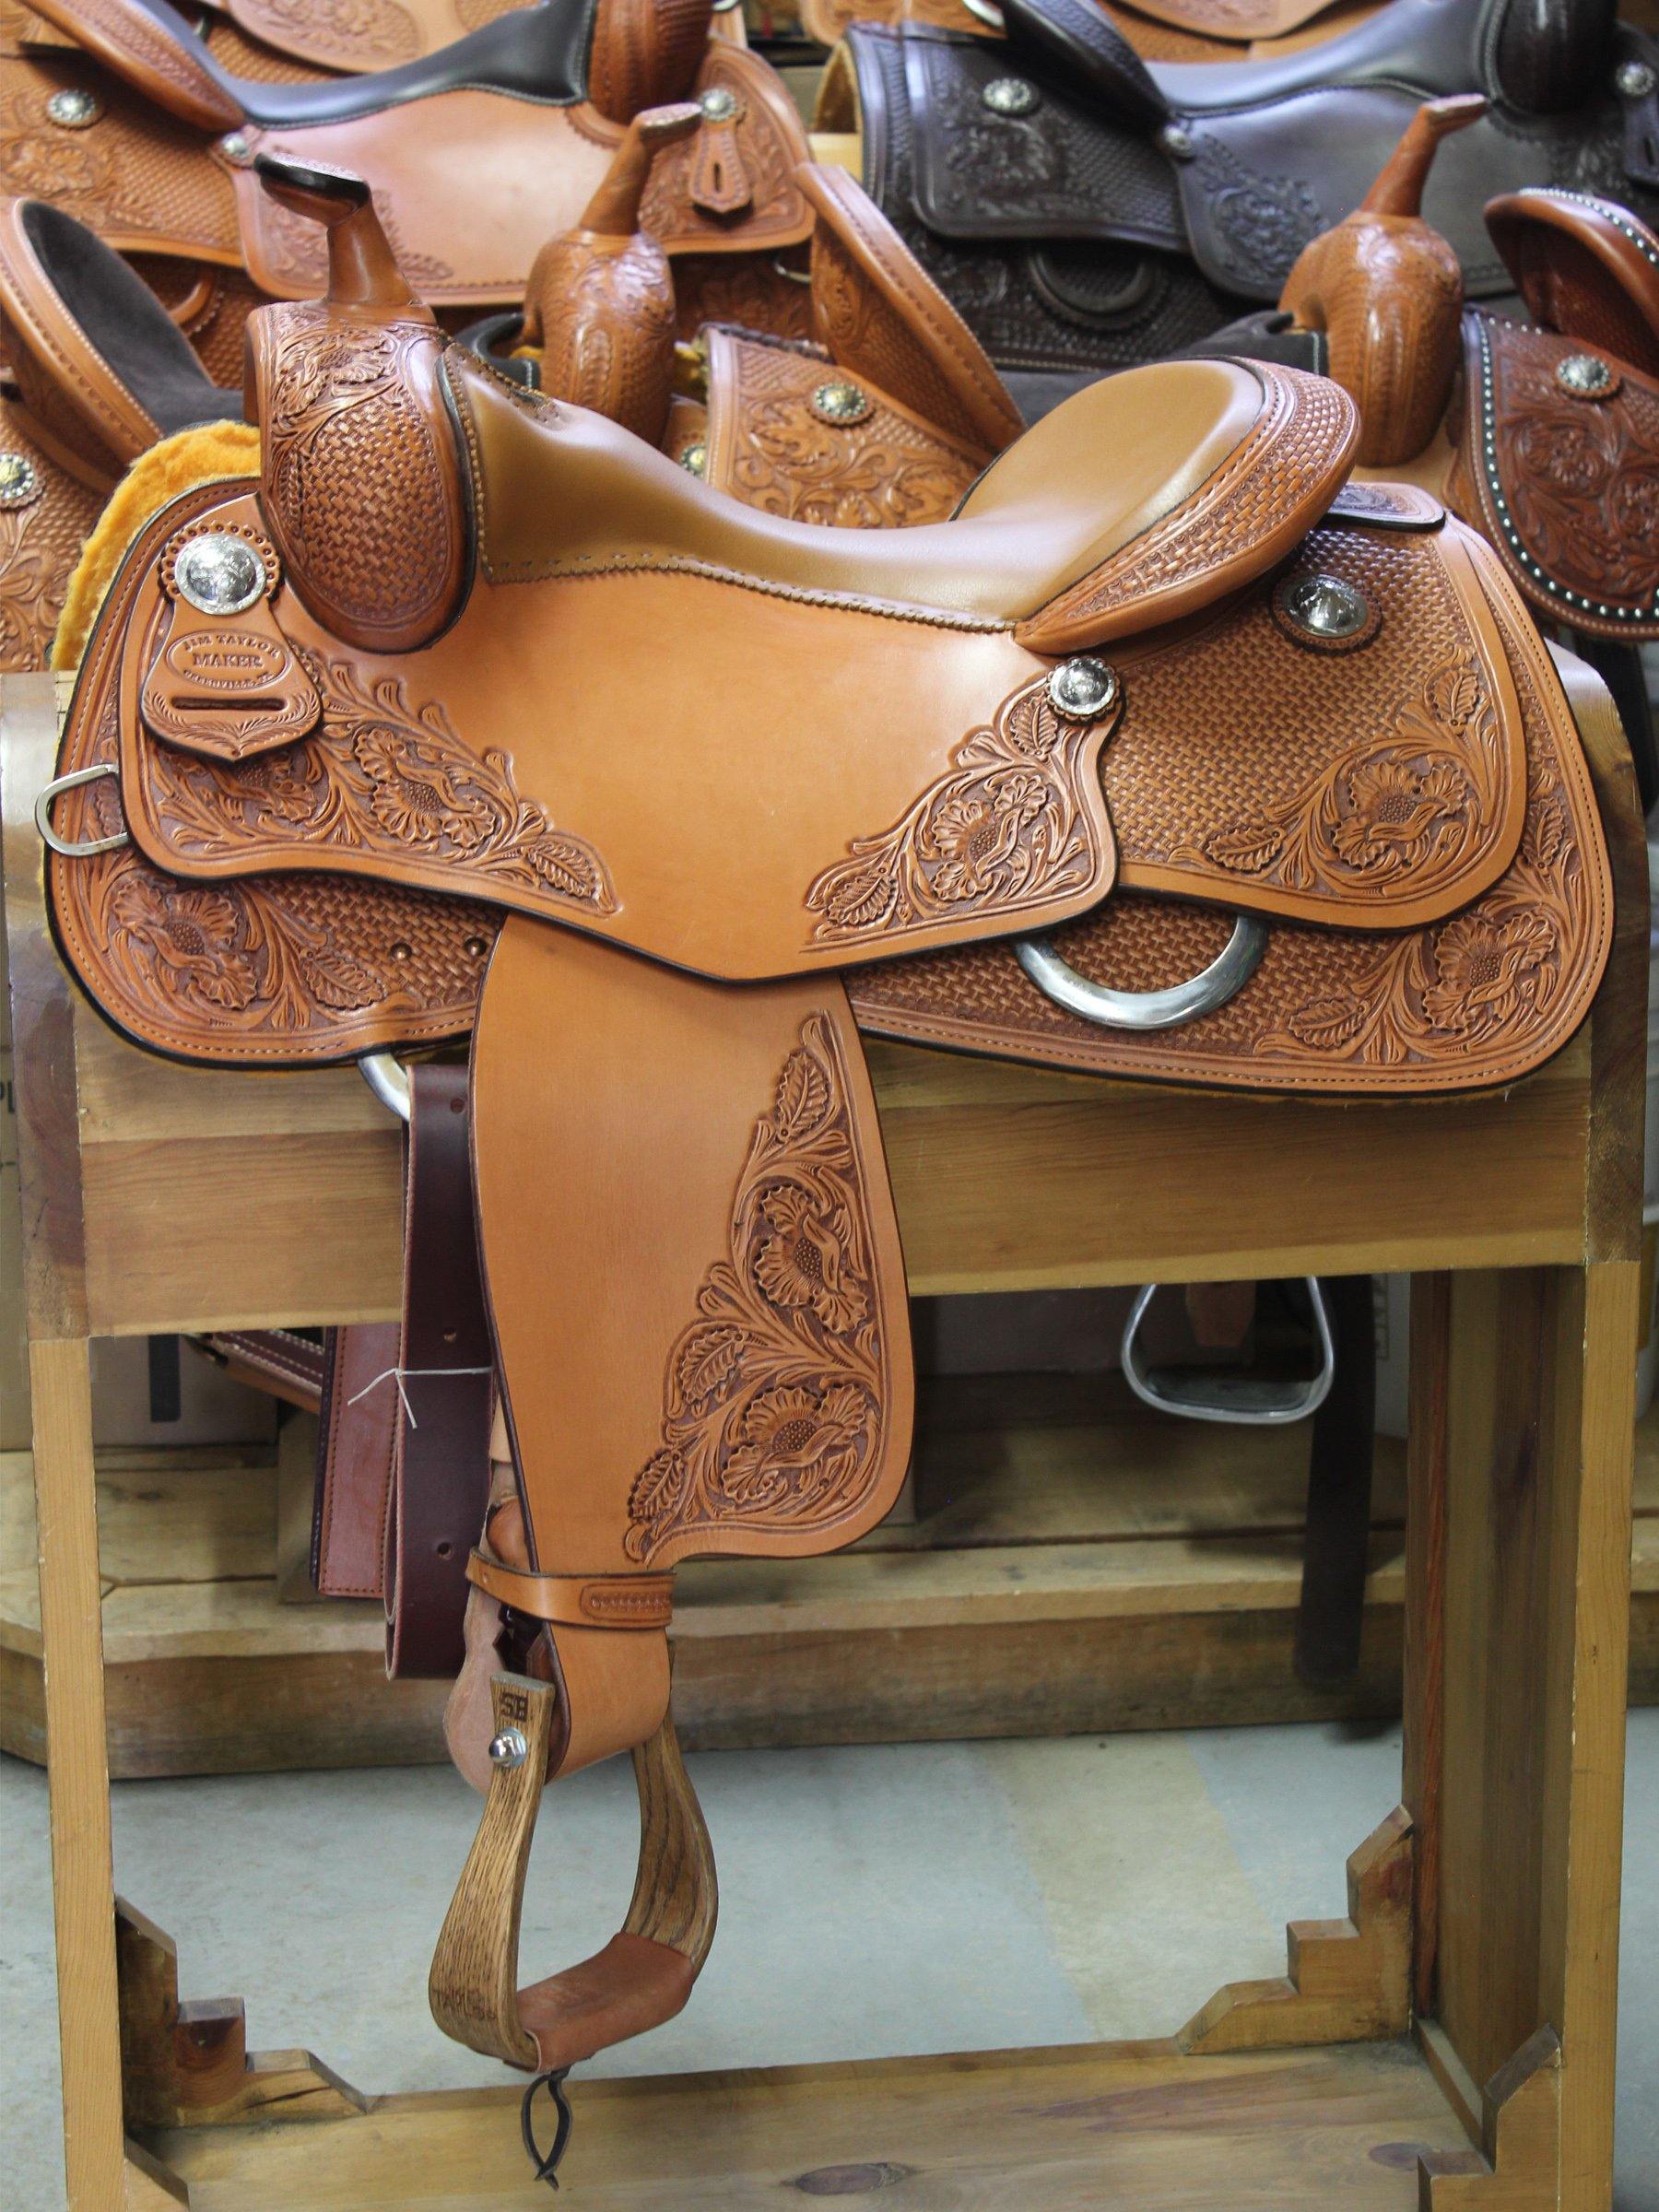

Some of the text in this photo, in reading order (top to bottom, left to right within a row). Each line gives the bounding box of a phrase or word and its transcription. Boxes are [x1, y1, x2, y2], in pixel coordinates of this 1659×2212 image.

[183, 633, 281, 659] JIM TAYLOR
[192, 652, 265, 668] MAKER
[499, 1691, 528, 1722] SB
